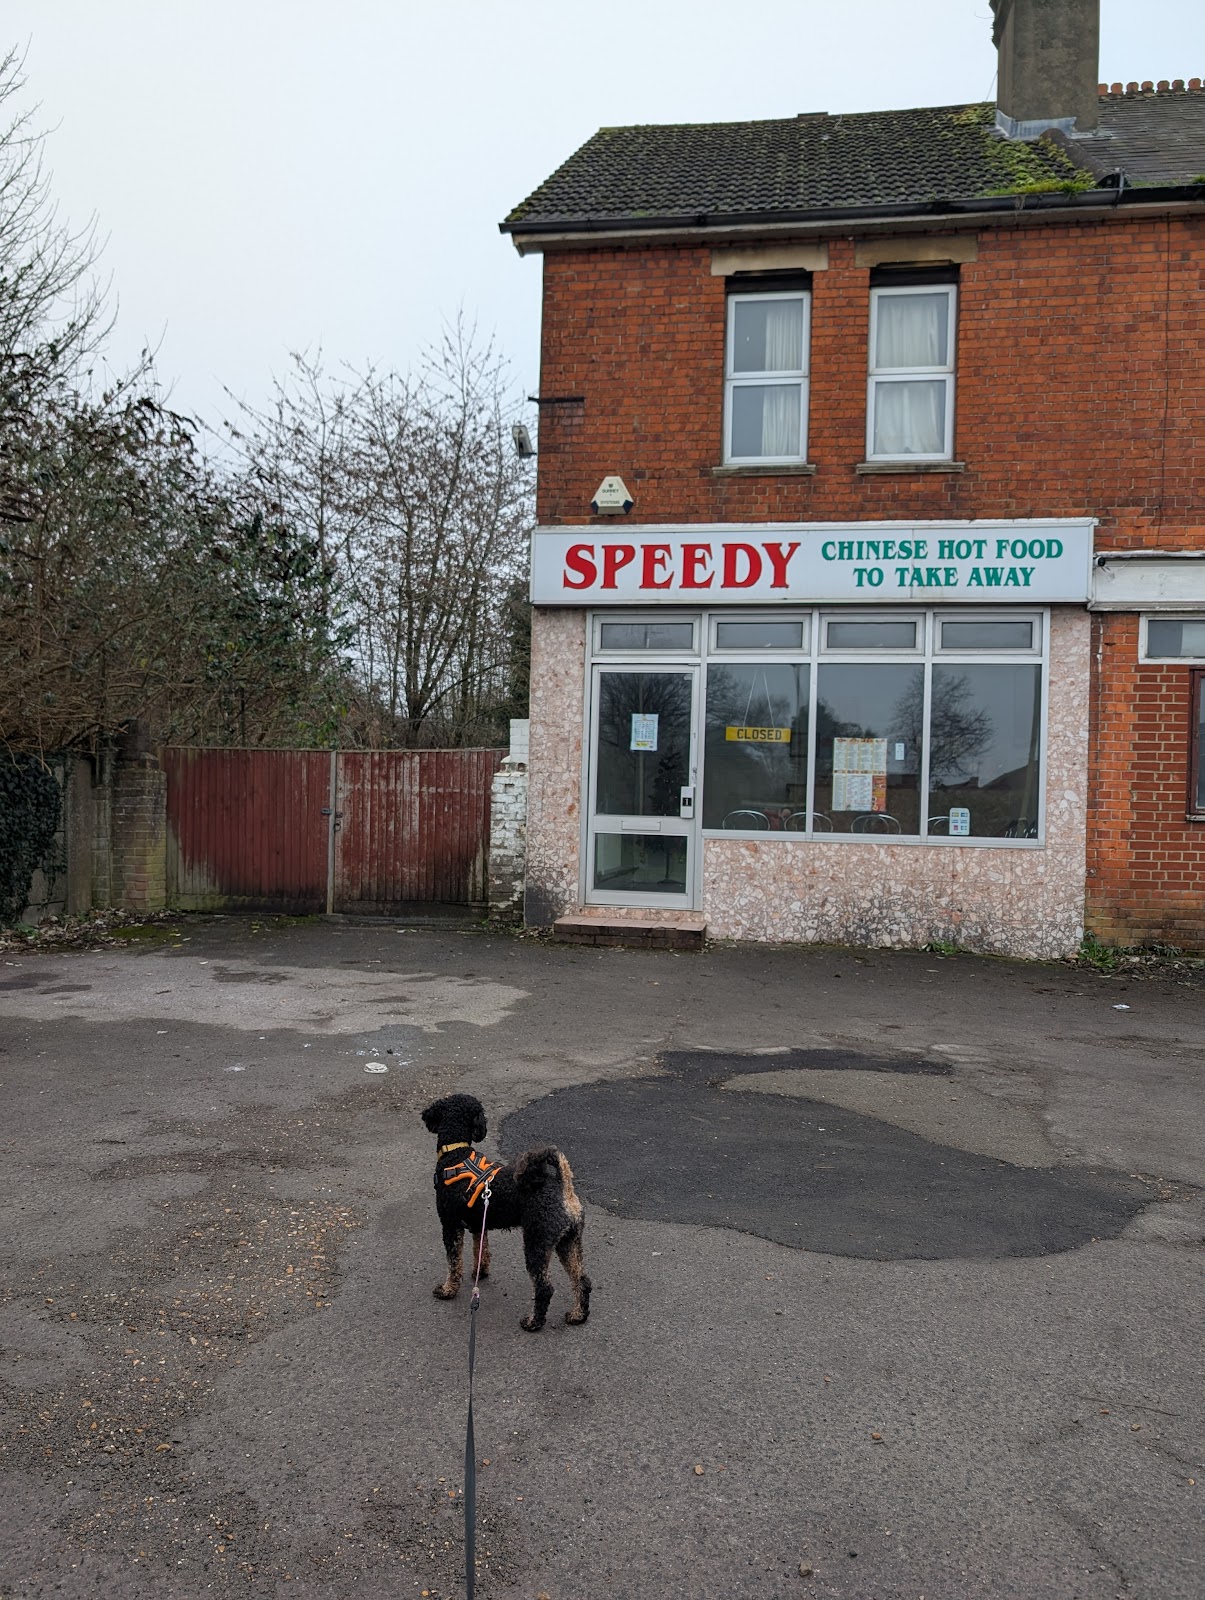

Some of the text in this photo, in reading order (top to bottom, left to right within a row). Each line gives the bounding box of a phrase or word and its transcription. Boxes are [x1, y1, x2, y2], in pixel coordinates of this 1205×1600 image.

[821, 538, 1063, 561] CHINESE HOT FOOD
[563, 542, 801, 589] SPEEDY
[853, 567, 1036, 587] TO TAKE AWAY
[737, 729, 782, 740] CLOSED
